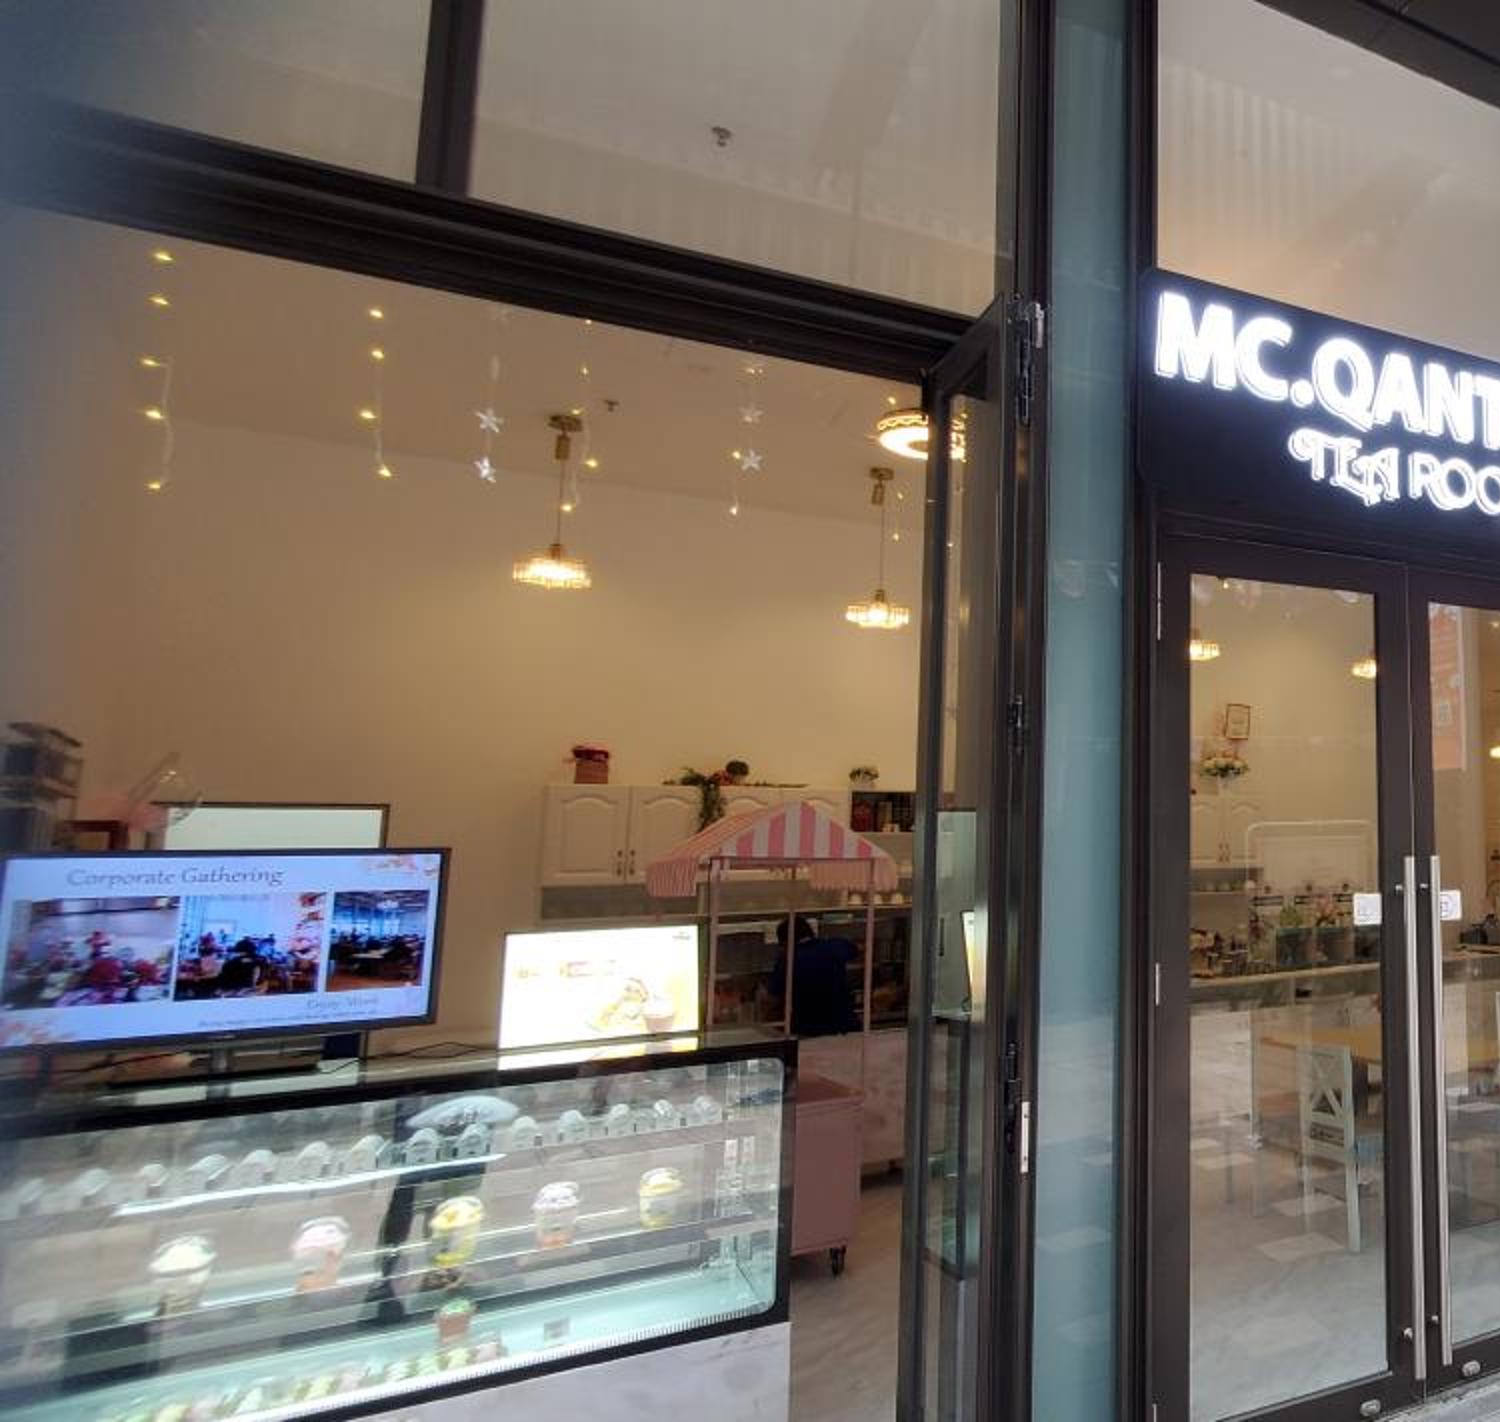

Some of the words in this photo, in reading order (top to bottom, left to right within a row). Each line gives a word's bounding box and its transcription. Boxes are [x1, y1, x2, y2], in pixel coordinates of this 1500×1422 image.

[1287, 427, 1400, 507] TEA
[66, 867, 176, 888] Corporate
[180, 865, 285, 887] Gathering
